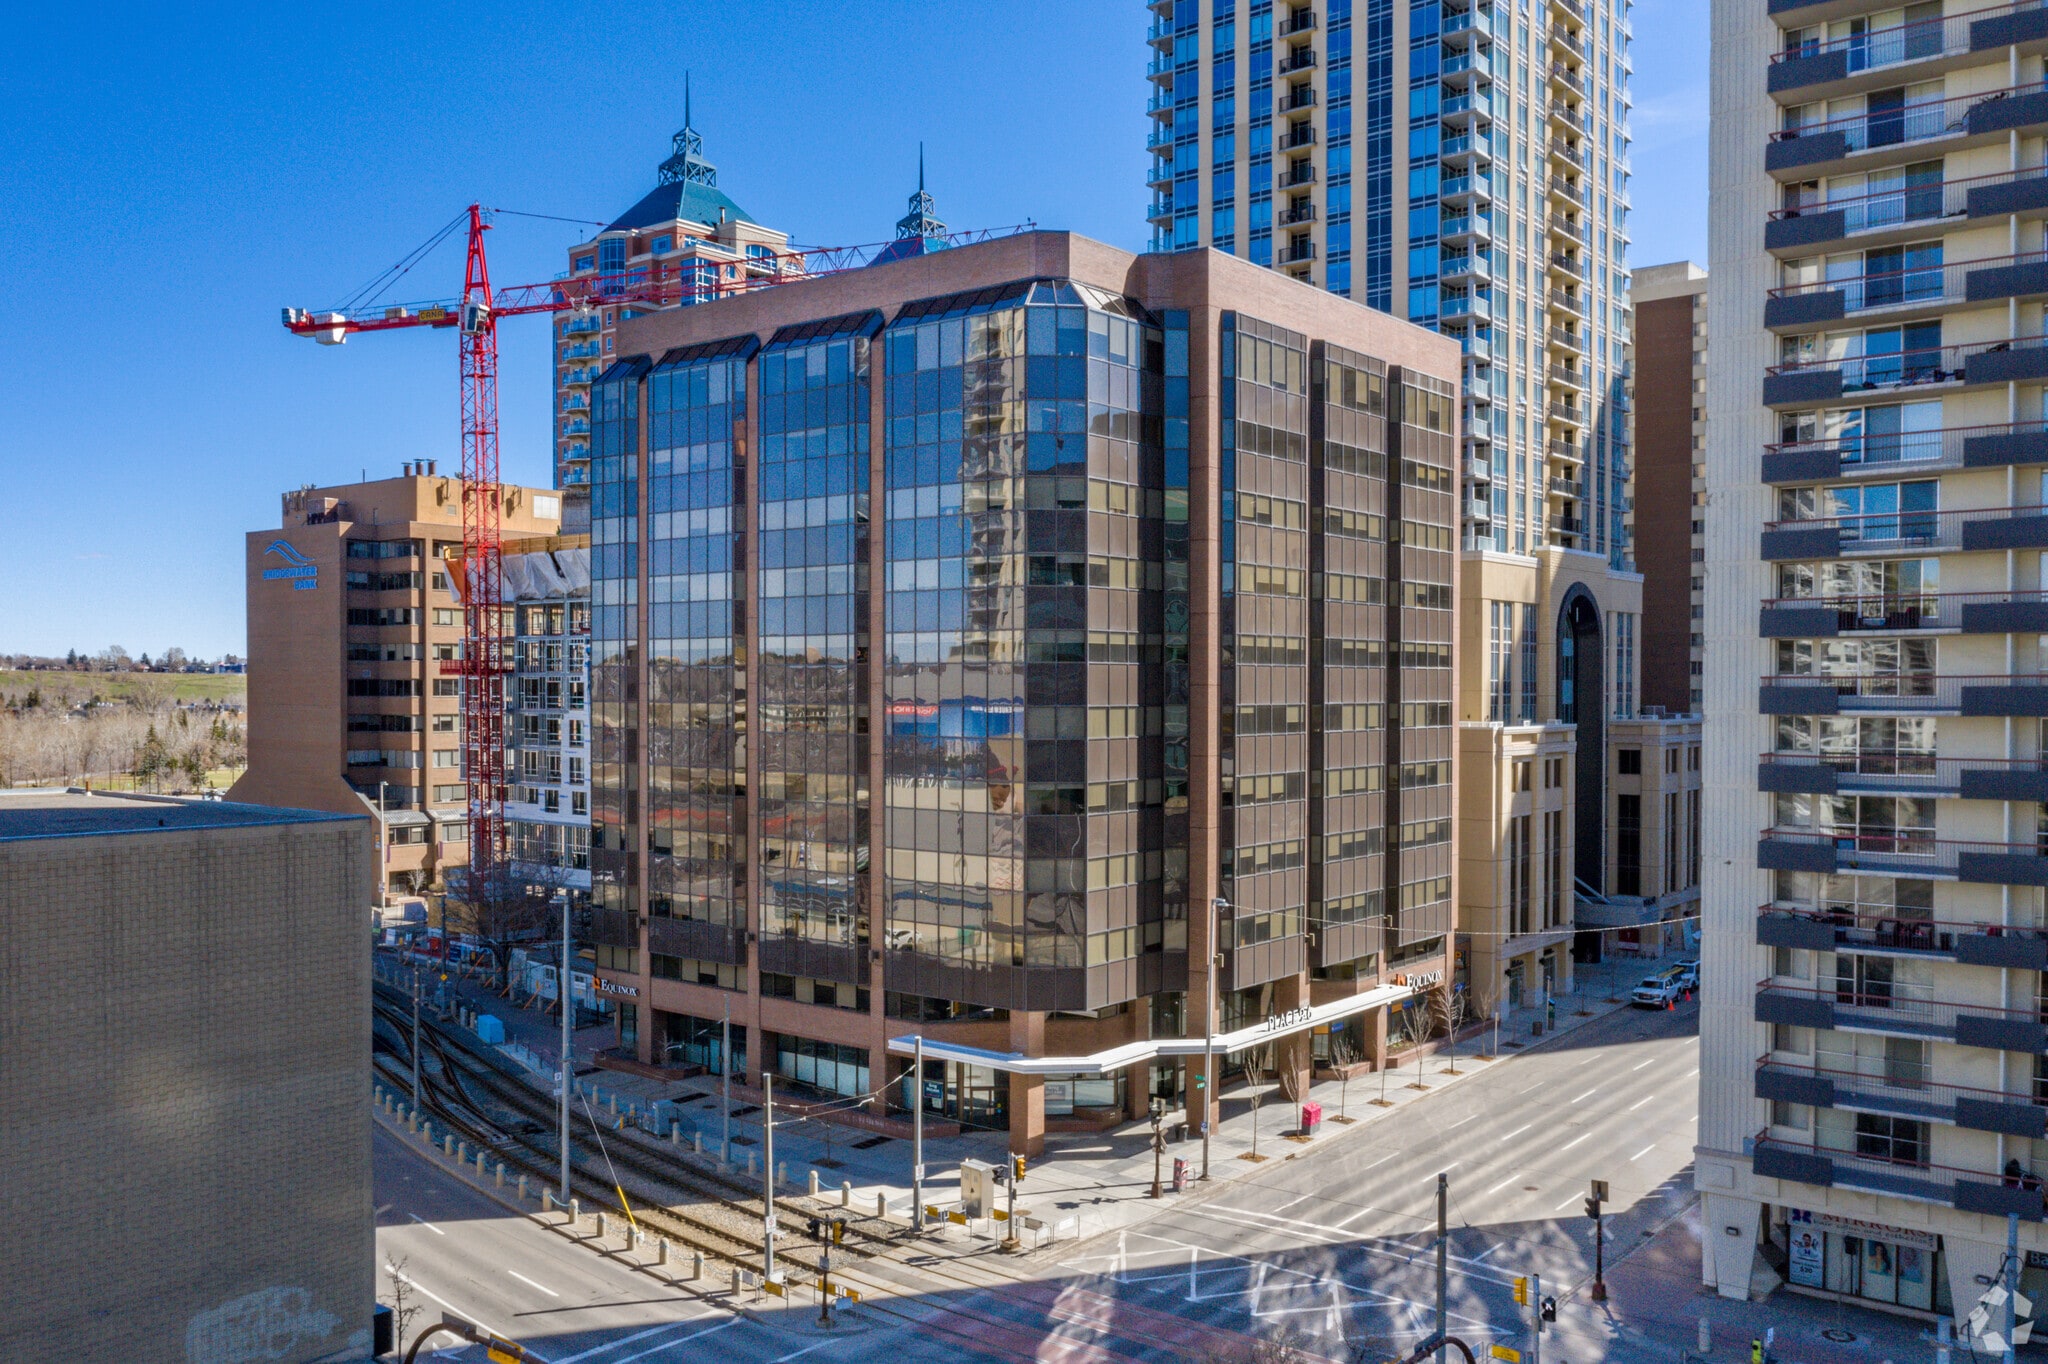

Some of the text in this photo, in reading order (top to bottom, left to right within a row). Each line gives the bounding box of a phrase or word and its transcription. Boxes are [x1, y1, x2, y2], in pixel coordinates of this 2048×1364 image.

[420, 310, 443, 320] CANA
[294, 579, 318, 591] BANK
[601, 979, 638, 997] EQUINOX
